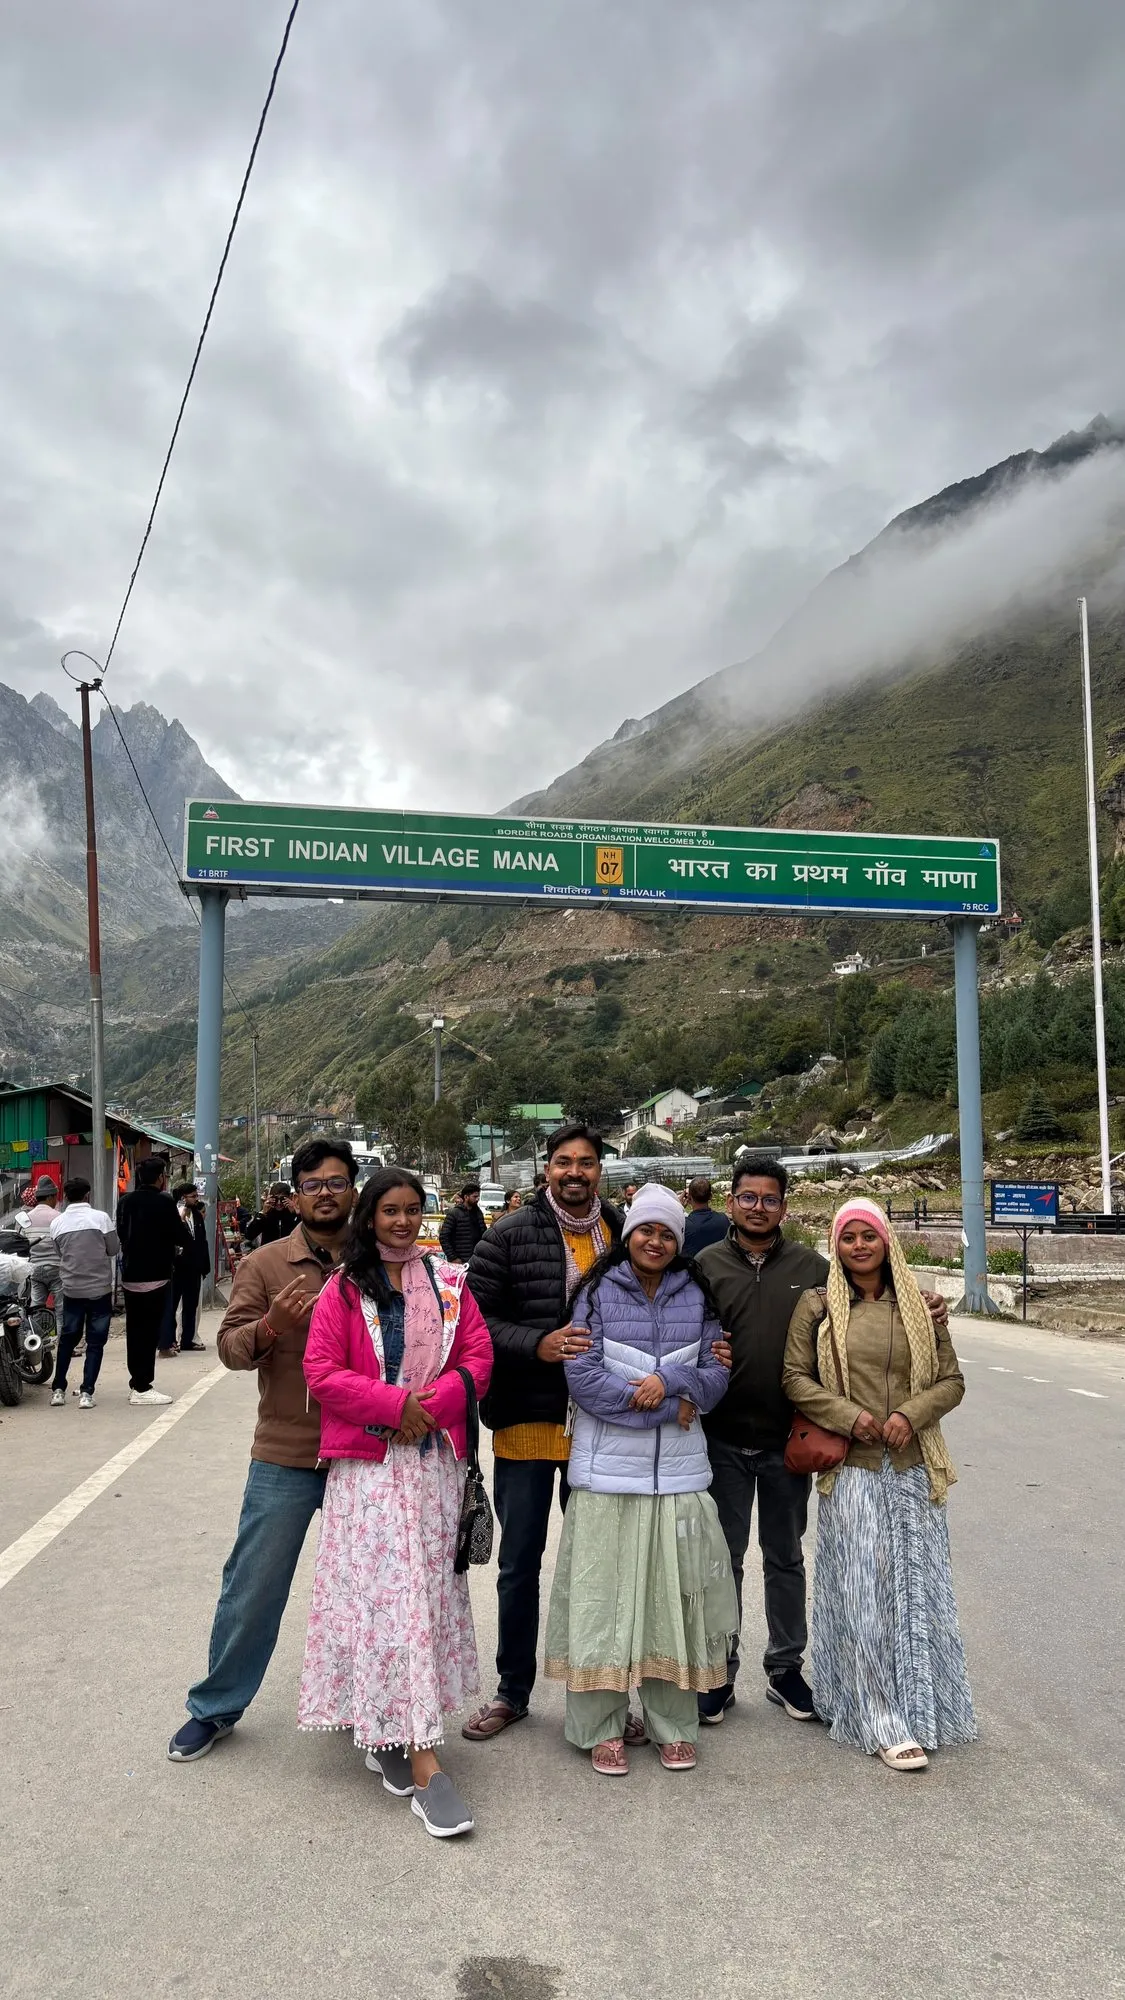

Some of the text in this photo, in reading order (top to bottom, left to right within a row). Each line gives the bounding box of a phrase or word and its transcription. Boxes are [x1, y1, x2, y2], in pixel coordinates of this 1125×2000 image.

[525, 821, 545, 830] सीमा
[579, 823, 606, 832] संगठन
[611, 826, 638, 834] आपका
[643, 828, 670, 836] स्वागत
[674, 829, 697, 837] करता
[701, 829, 708, 838] है
[497, 829, 537, 837] BORDER
[540, 831, 573, 839] ROADS
[575, 833, 641, 843] ORGANISATION
[644, 836, 694, 845] WELCOMES
[206, 835, 560, 872] FIRST INDIAN VILLAGE MANA
[603, 851, 616, 859] NH
[198, 869, 229, 878] 21 BRTF
[600, 861, 619, 875] 07
[668, 858, 978, 889] भारत का प्रथम गाँव माणा
[543, 884, 592, 895] शिवालिक
[619, 888, 667, 897] SHIVALIK
[962, 902, 989, 911] 75 RCC
